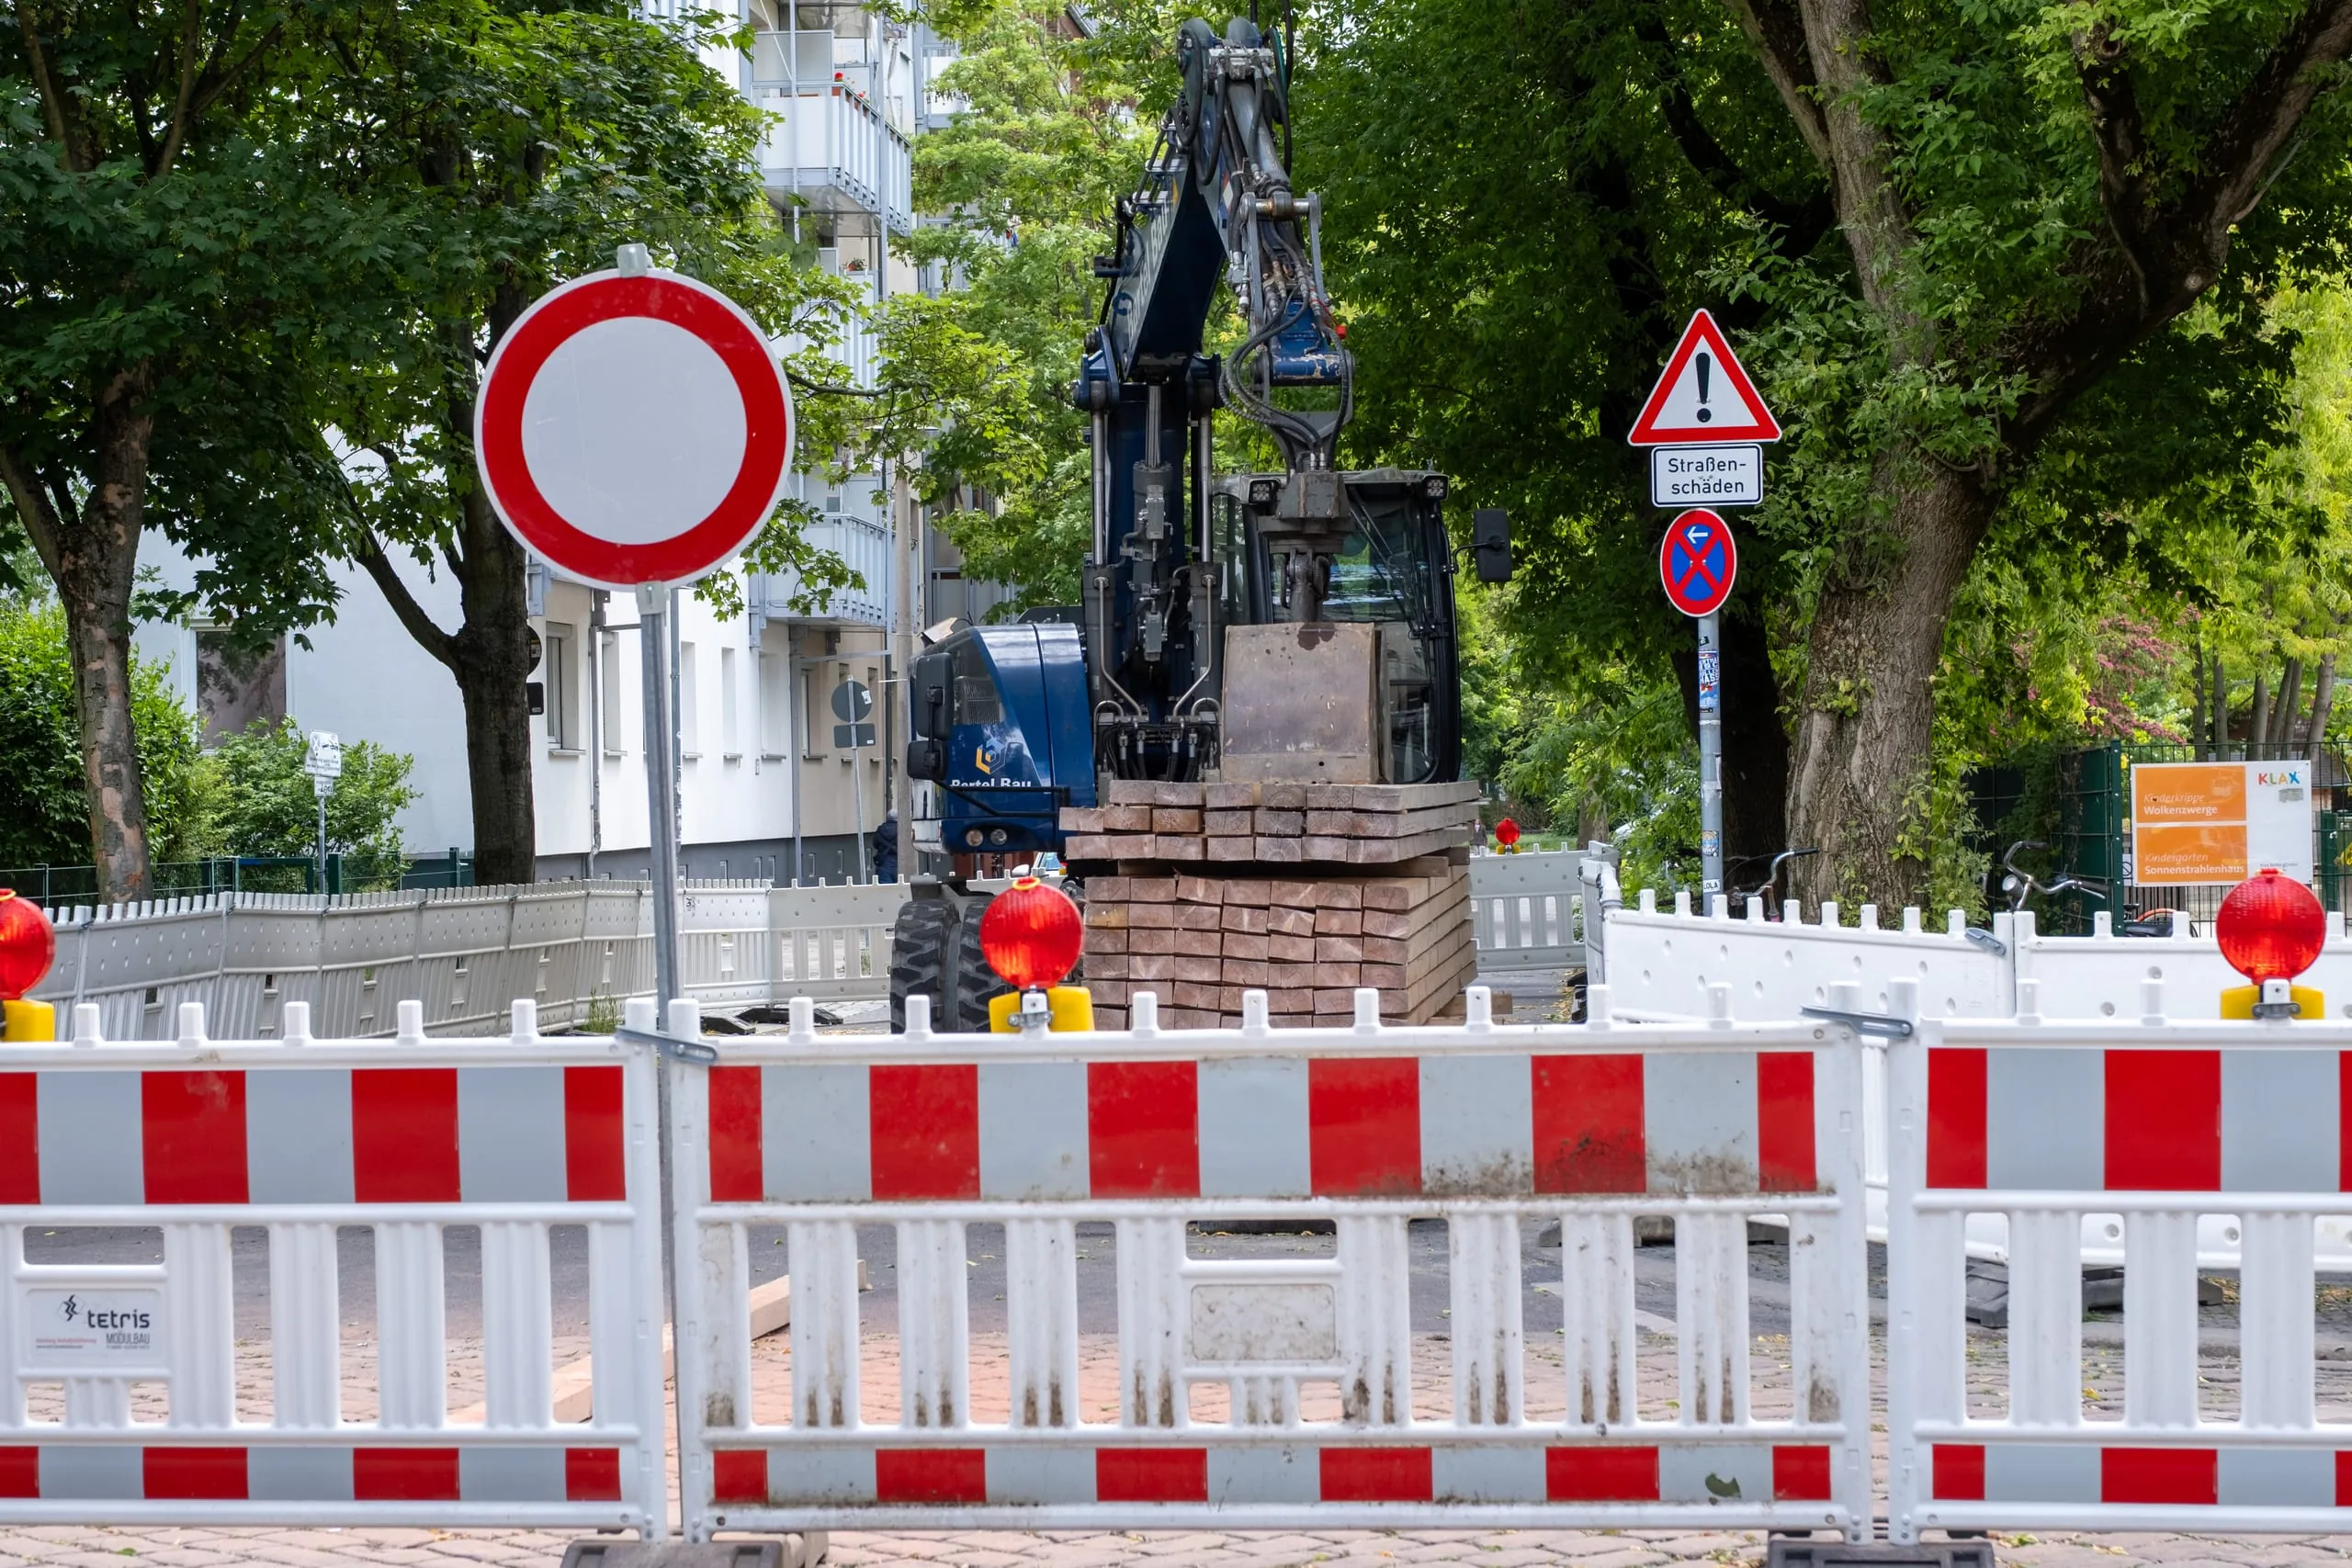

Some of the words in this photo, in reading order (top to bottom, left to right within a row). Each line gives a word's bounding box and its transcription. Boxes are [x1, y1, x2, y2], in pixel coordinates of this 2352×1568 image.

[1668, 457, 1747, 472] Straßen-
[1671, 479, 1744, 494] schäden
[2258, 772, 2300, 785] KLAX
[2143, 794, 2204, 804] Kinderkrippe
[2143, 806, 2218, 816] Wolkenzwerge
[2144, 852, 2208, 864] Kindergarten
[2145, 864, 2245, 874] Sonnenstrahlenhaus
[87, 1309, 151, 1328] tetris
